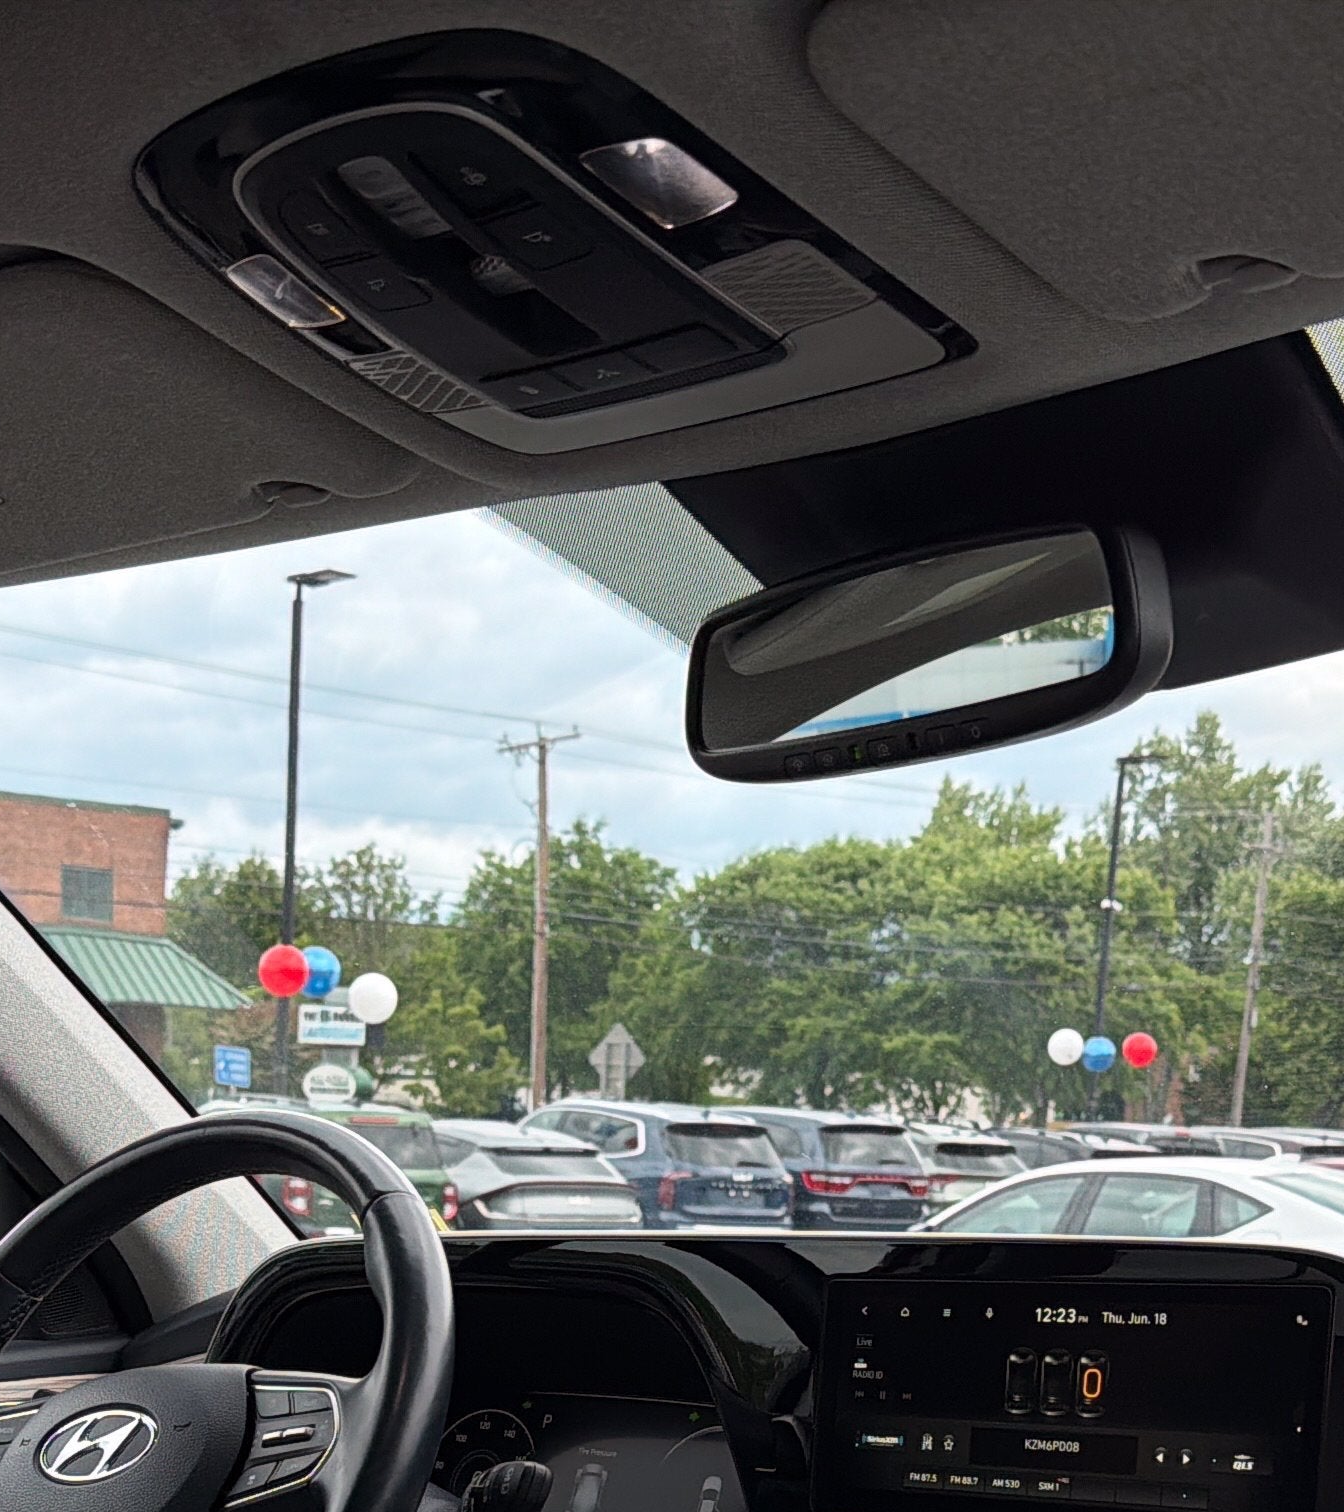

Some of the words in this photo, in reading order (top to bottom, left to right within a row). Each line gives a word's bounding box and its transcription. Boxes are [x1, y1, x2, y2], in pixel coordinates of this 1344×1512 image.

[1035, 1307, 1077, 1324] 12:23
[1078, 1315, 1089, 1323] PM
[1128, 1312, 1151, 1325] Jun.
[1154, 1312, 1168, 1325] 18
[856, 1337, 873, 1347] Live
[852, 1370, 874, 1379] RADIO
[875, 1371, 884, 1380] ID
[542, 1414, 553, 1429] P
[1024, 1438, 1080, 1453] KZM6PD08
[909, 1472, 920, 1482] FM
[920, 1473, 937, 1483] 87.5
[950, 1475, 961, 1485] FM
[992, 1478, 1004, 1488] AM
[1004, 1479, 1020, 1489] 530
